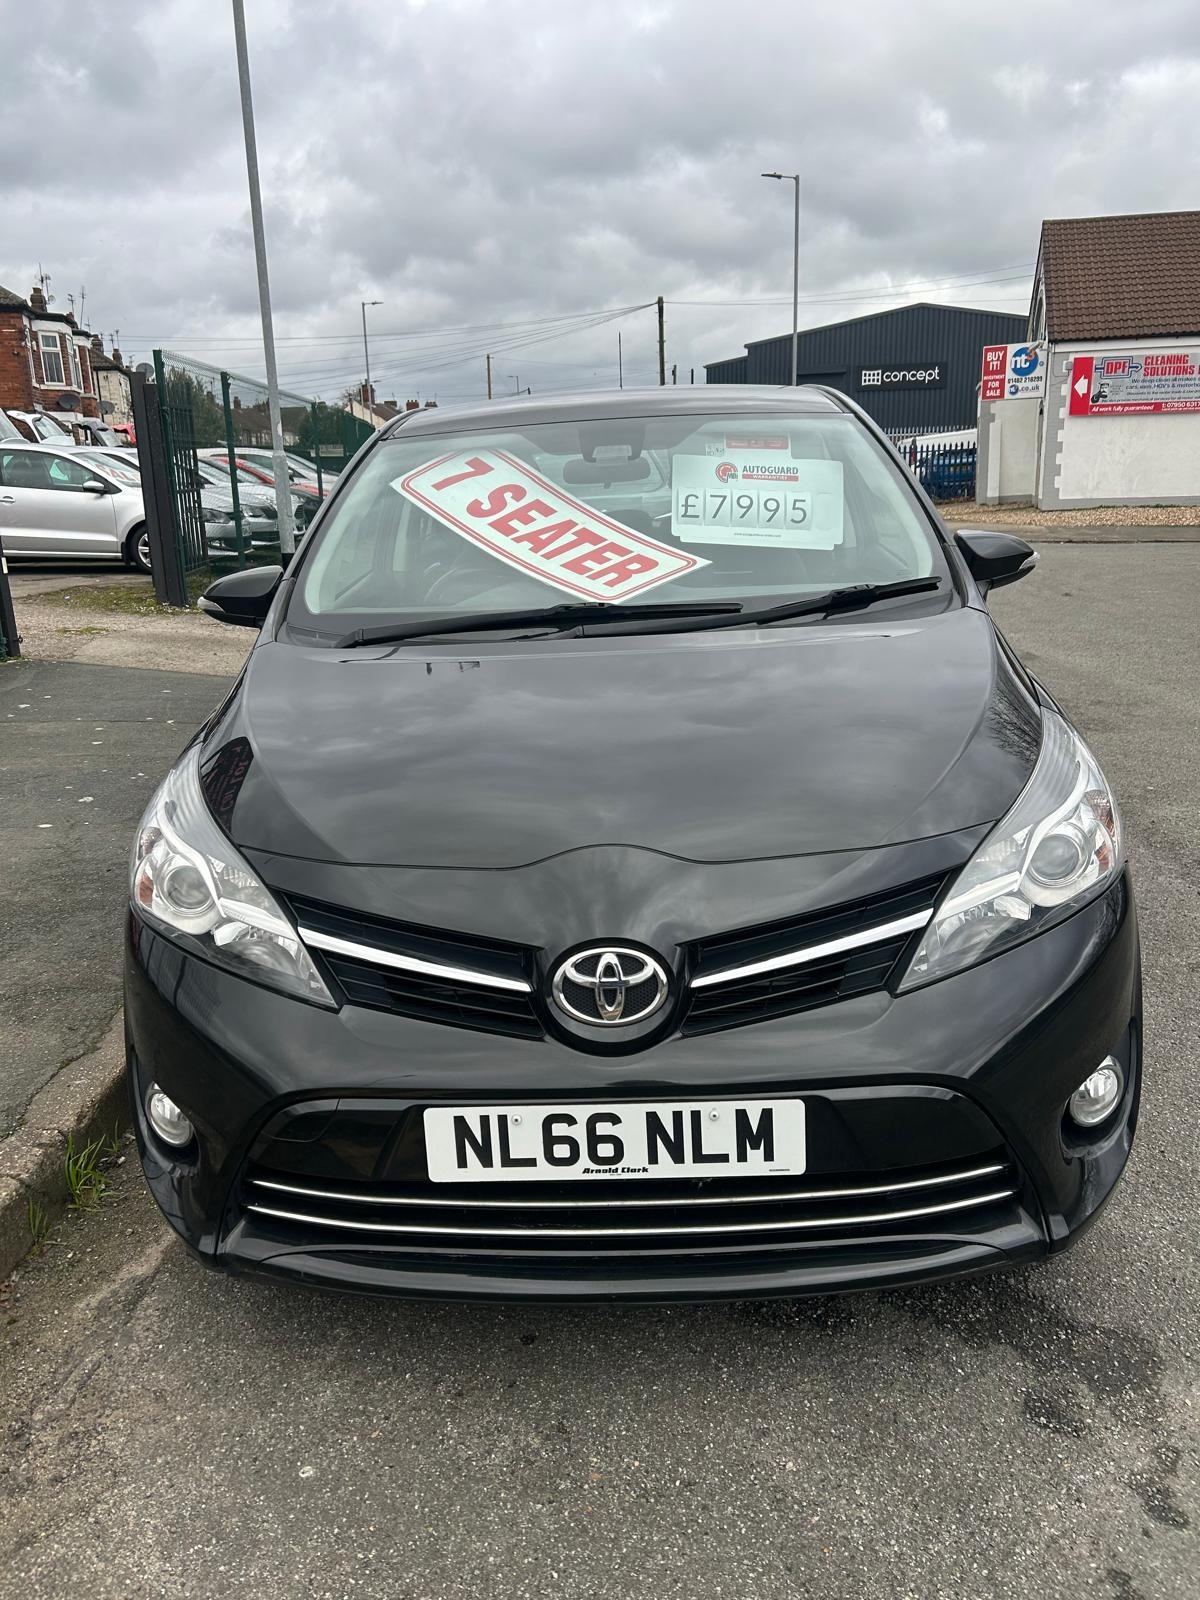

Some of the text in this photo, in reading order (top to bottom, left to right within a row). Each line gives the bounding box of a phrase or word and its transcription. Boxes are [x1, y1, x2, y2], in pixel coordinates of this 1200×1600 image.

[986, 350, 1005, 362] BUY
[1144, 354, 1190, 366] CLEANING
[989, 361, 1001, 371] IT!
[1105, 360, 1128, 375] DPF
[1143, 364, 1195, 377] SOLUTIONS
[883, 366, 940, 384] concept
[985, 389, 1001, 397] SALE
[1112, 404, 1123, 413] fully
[1123, 404, 1154, 413] guaranteed
[742, 465, 799, 475] AUTOGUARD
[431, 456, 660, 588] 7 SEATER
[453, 1107, 775, 1168] NL66 NLM
[582, 1166, 619, 1175] Arnold
[620, 1166, 650, 1174] Clark
